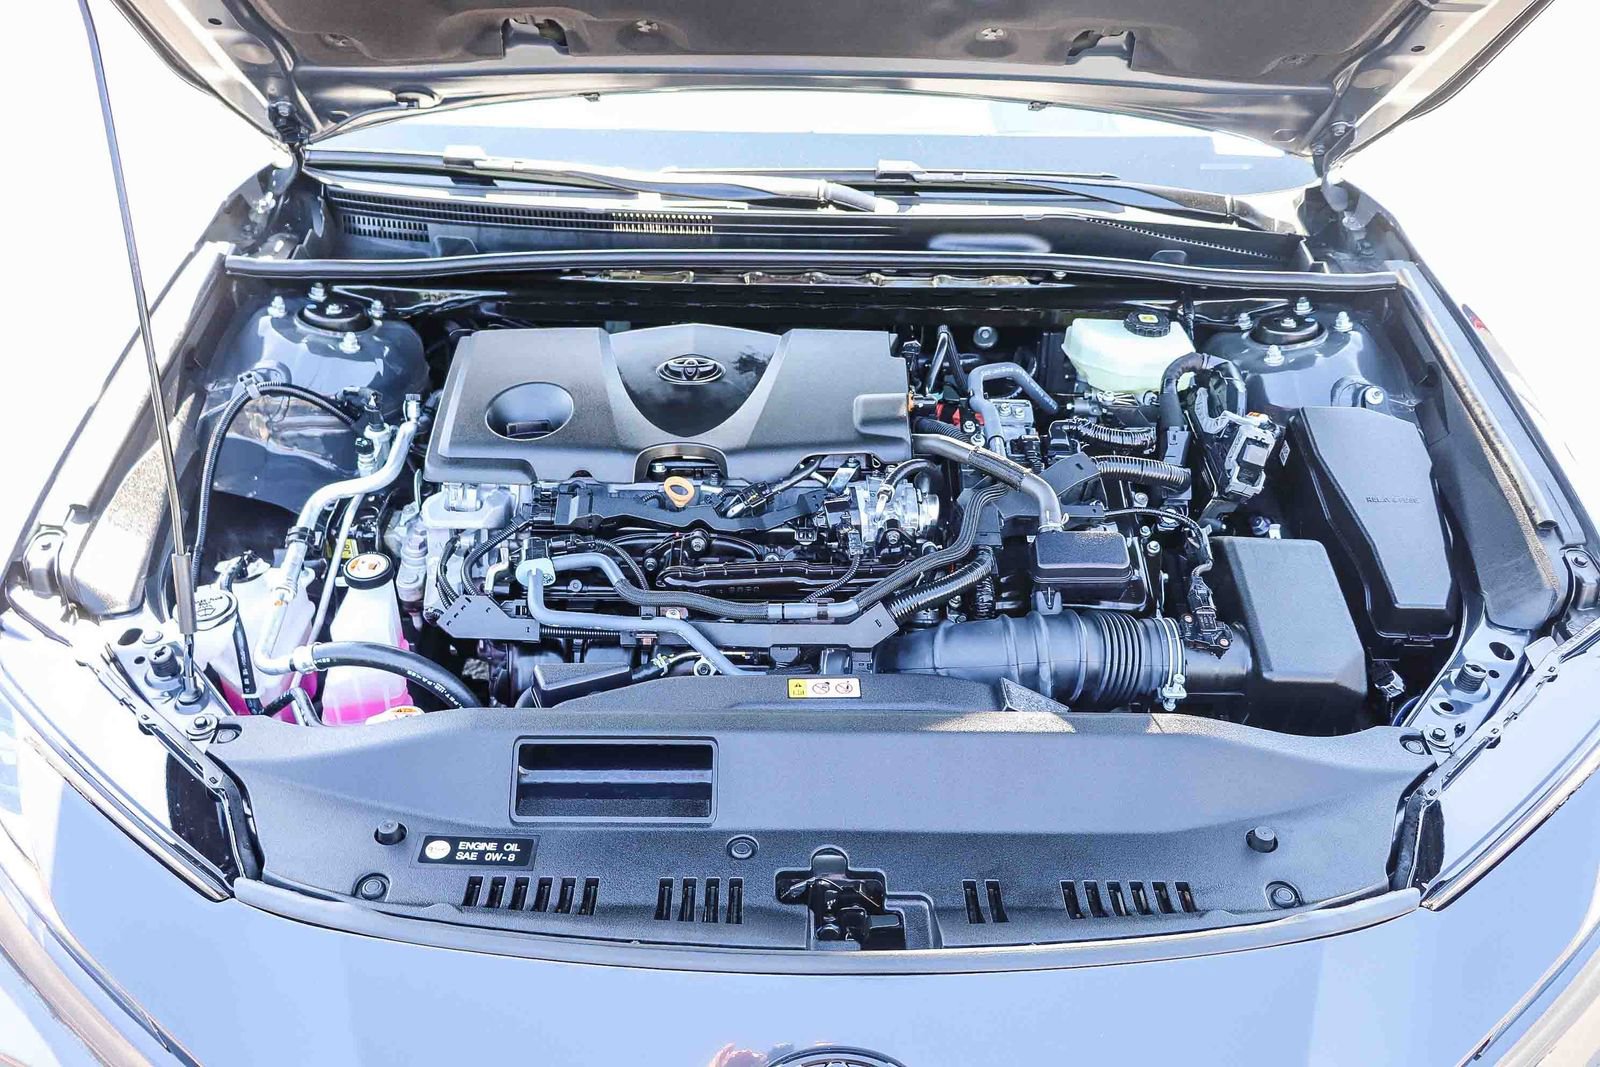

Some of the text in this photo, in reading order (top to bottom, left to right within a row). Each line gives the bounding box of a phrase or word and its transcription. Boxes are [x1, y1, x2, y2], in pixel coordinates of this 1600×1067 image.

[458, 841, 520, 851] ENGINE OIL
[456, 851, 515, 862] SAE 0W-8
